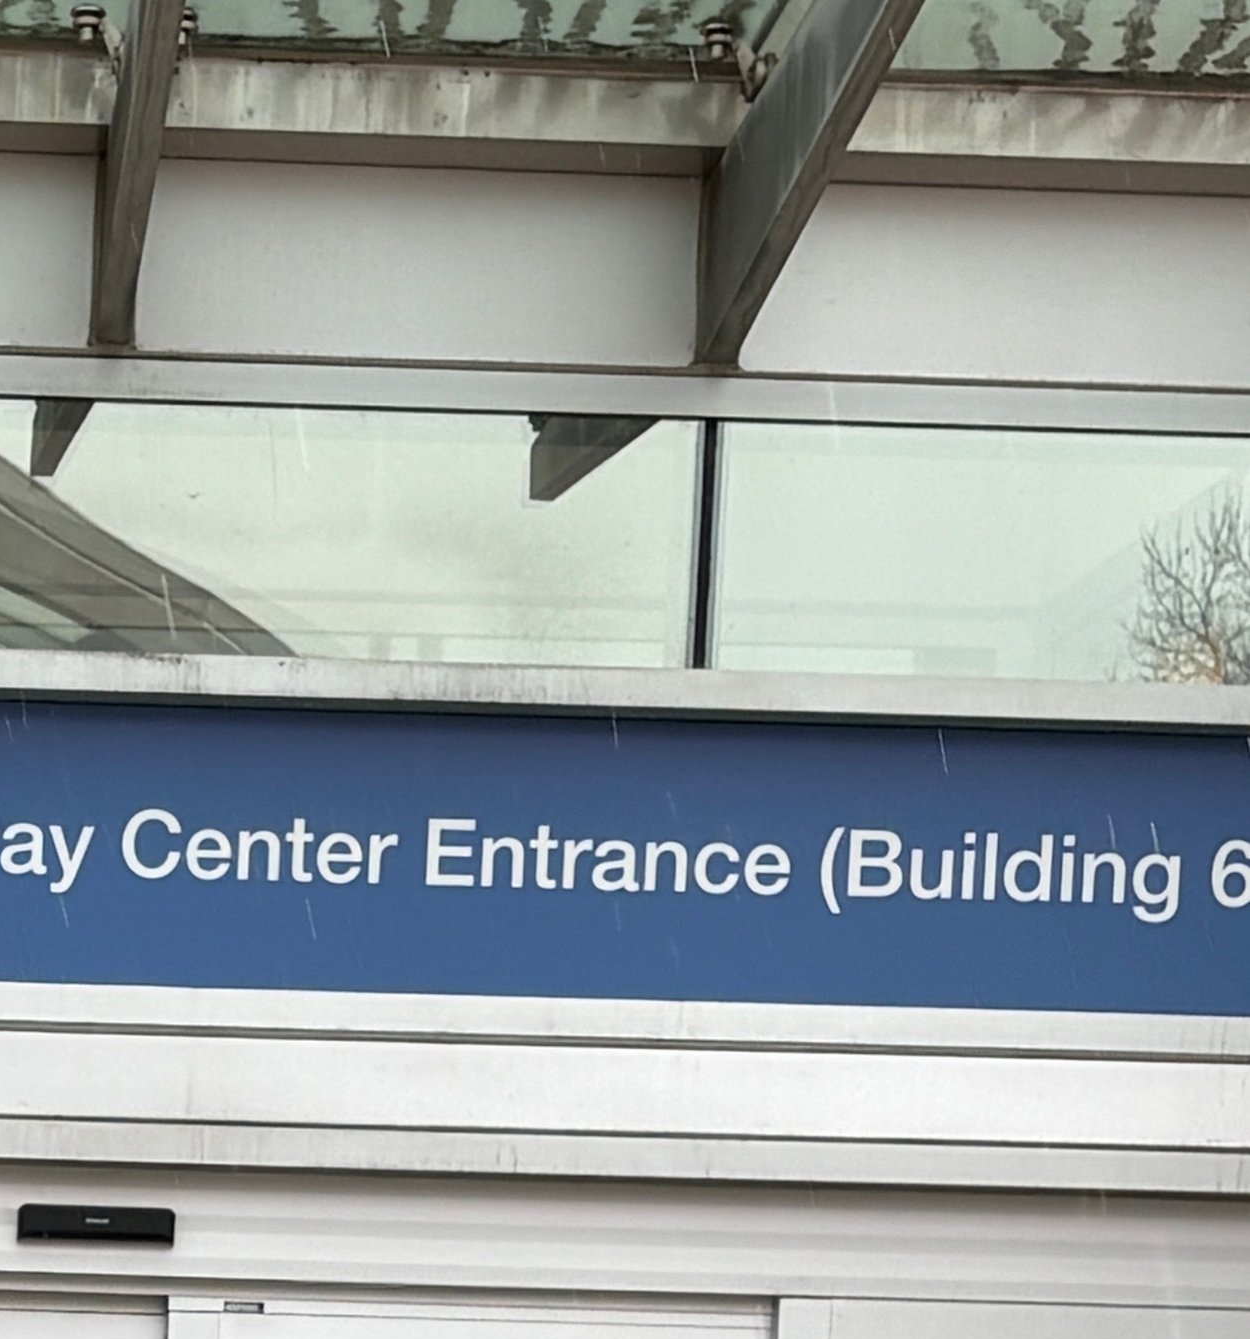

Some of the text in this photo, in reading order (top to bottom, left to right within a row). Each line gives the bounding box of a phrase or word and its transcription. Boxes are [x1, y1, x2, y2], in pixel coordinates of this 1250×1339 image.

[121, 808, 399, 884] Center
[425, 818, 791, 896] Entrance
[818, 822, 1182, 923] (Building
[1211, 839, 1250, 908] 6
